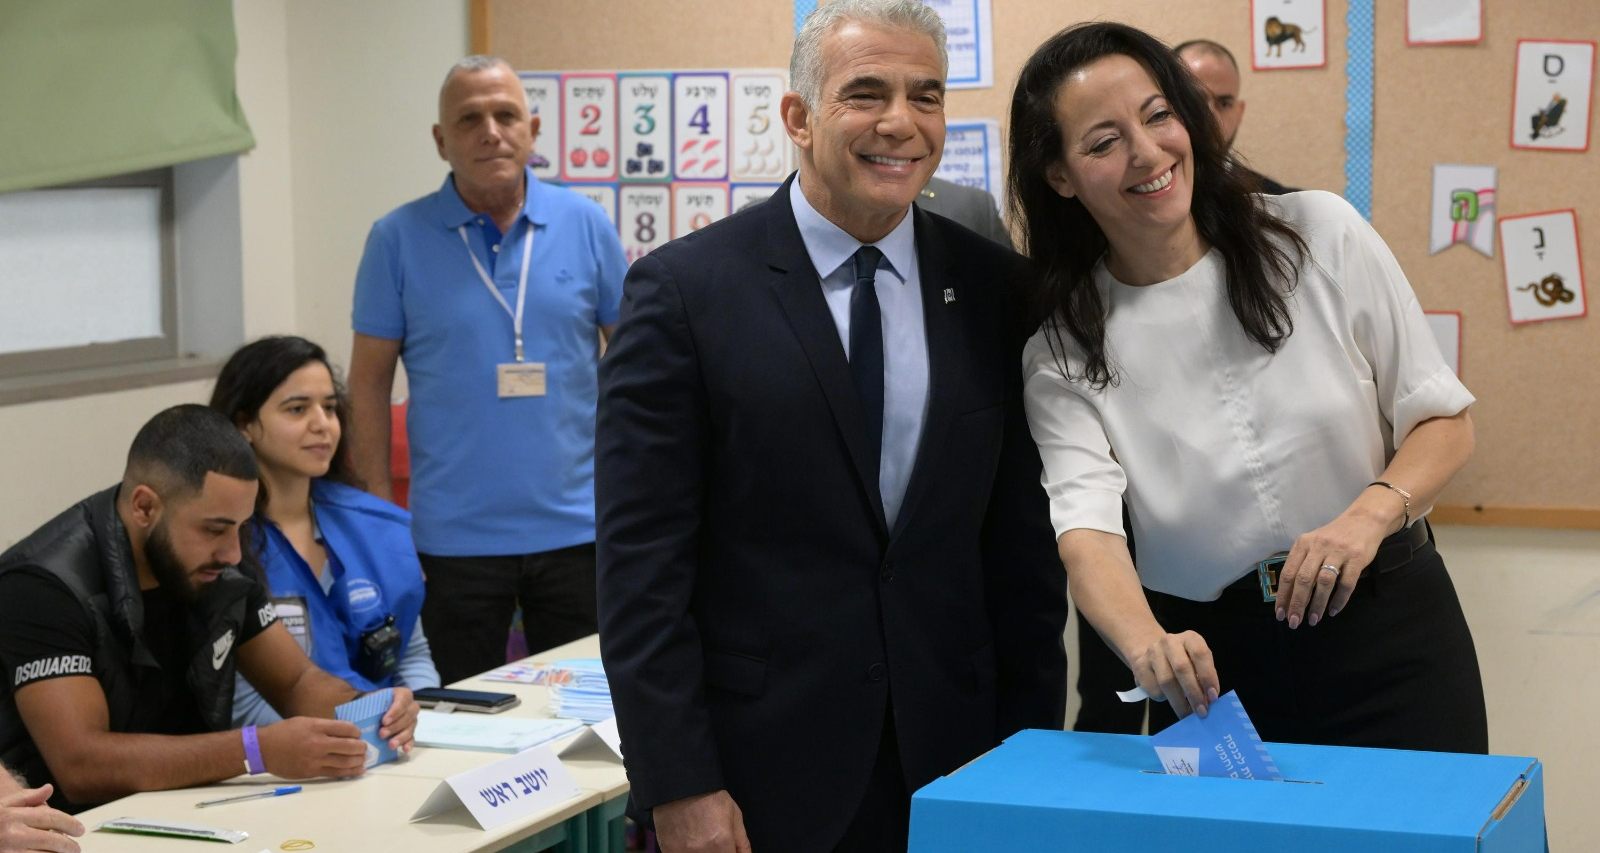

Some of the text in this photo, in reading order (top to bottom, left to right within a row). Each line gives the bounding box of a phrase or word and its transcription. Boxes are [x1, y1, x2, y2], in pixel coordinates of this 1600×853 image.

[579, 104, 602, 135] 2
[634, 104, 656, 135] 3
[688, 104, 710, 135] 4
[748, 104, 770, 136] 5
[1451, 189, 1479, 222] ה
[635, 212, 656, 243] 8
[14, 654, 92, 685] DSQUARED2
[1214, 743, 1234, 772] וחמש
[1223, 733, 1246, 765] לכנסת
[479, 767, 549, 808] יושב ראש
